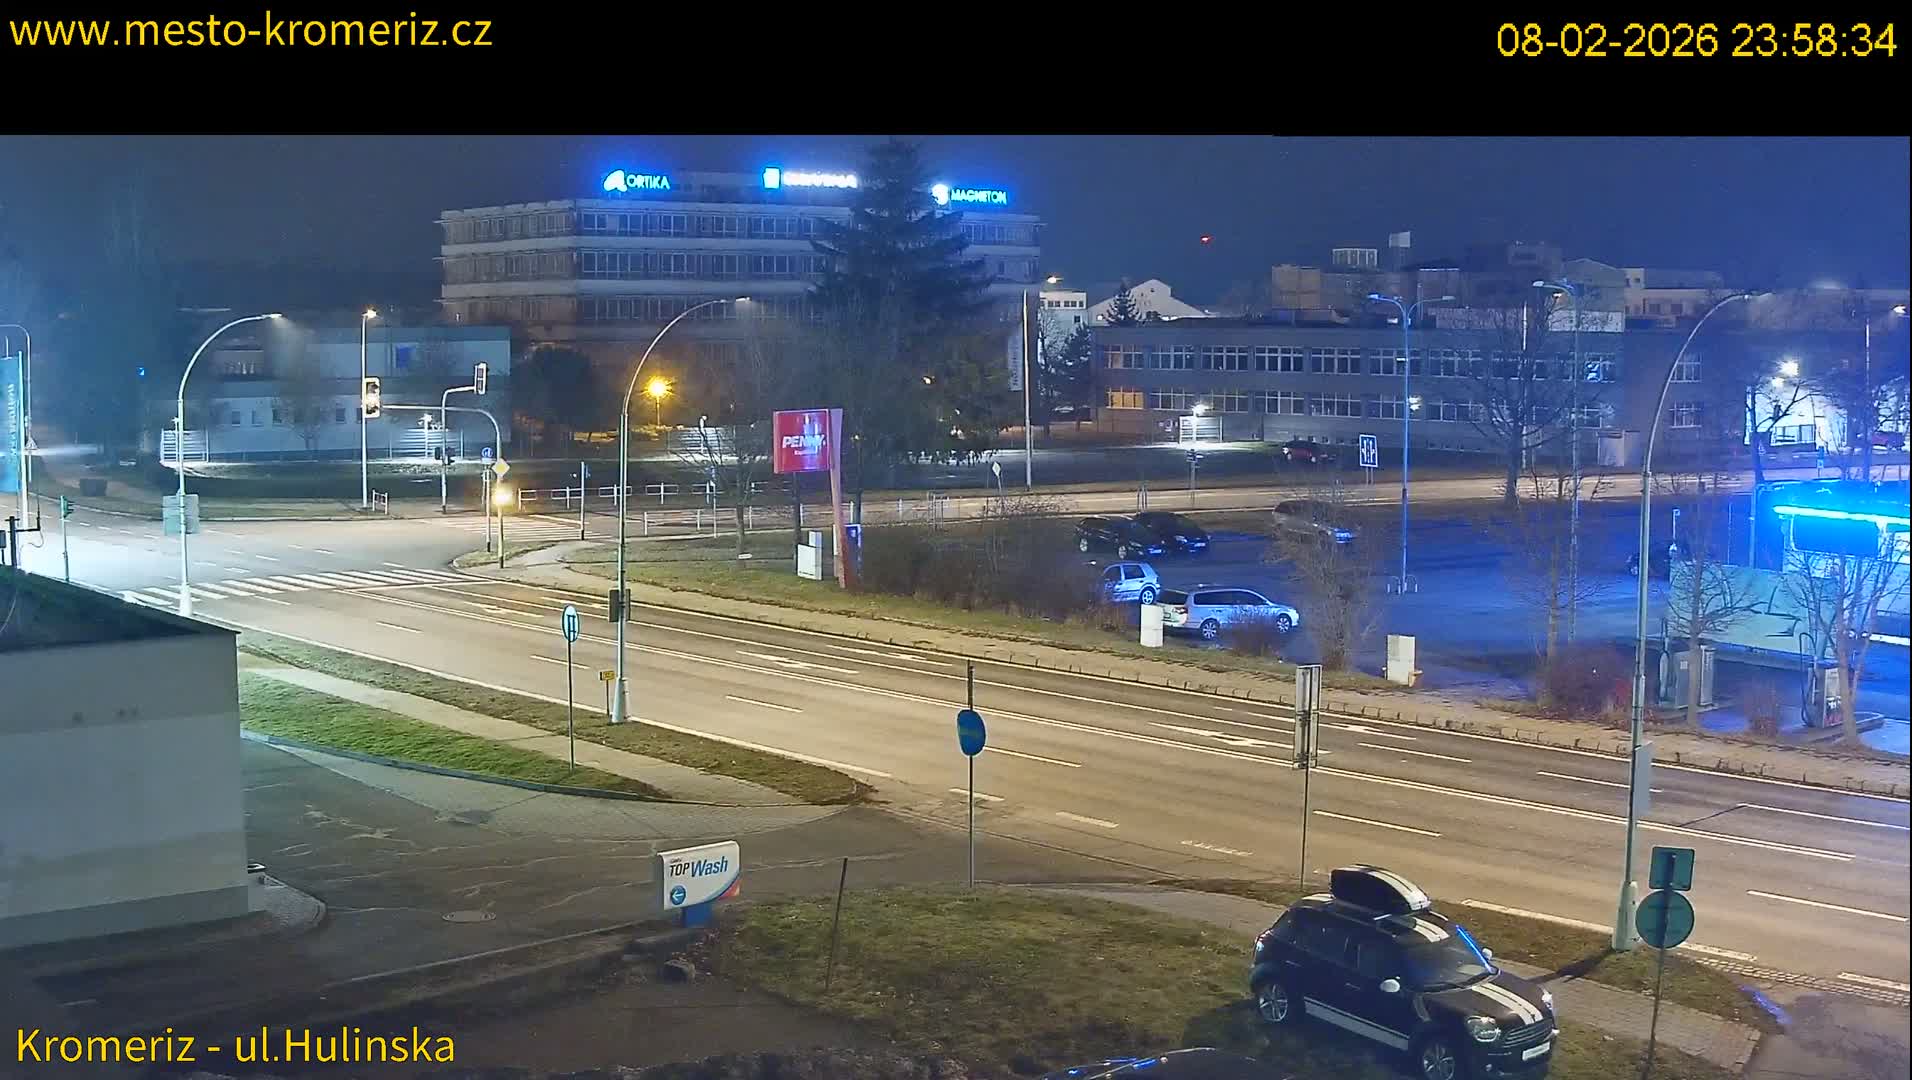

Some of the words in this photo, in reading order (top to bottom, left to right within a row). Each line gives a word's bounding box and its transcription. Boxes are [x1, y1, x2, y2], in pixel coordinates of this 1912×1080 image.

[626, 174, 671, 190] ORTIKA
[951, 189, 1007, 205] MAGNETON
[669, 862, 690, 877] TOP
[691, 856, 729, 878] Wash
